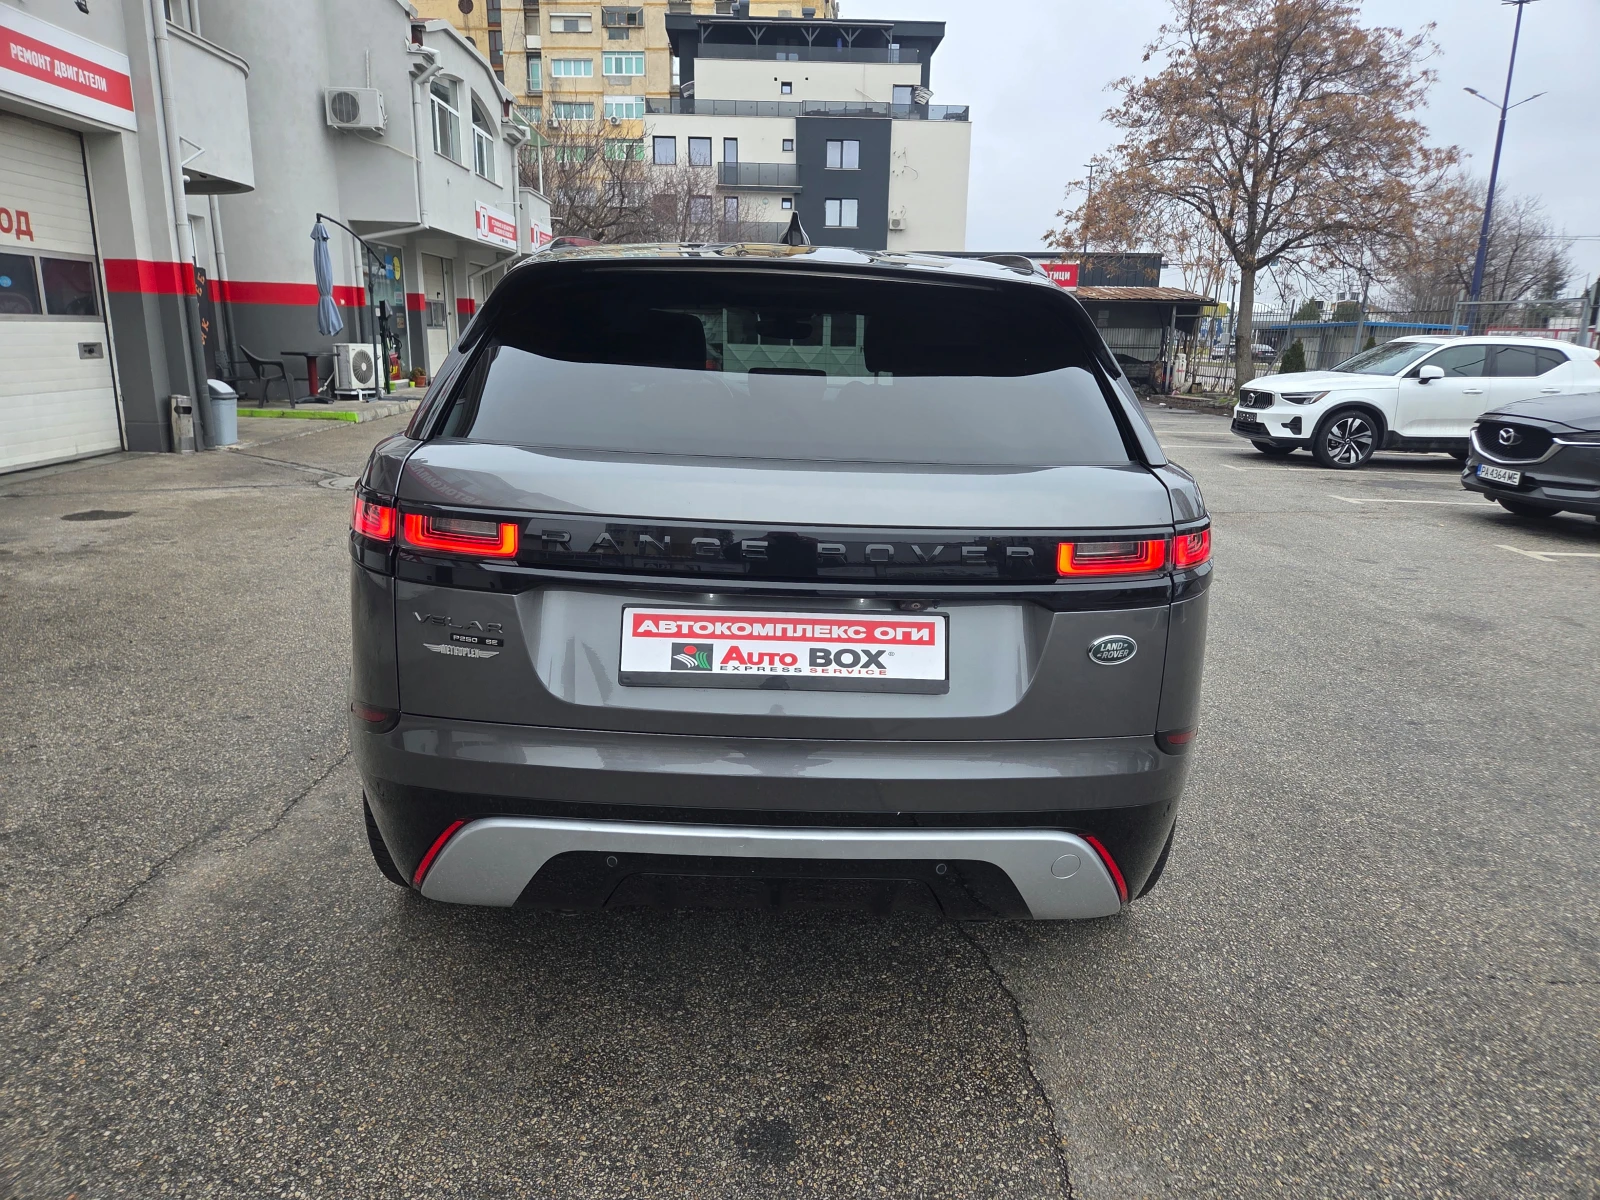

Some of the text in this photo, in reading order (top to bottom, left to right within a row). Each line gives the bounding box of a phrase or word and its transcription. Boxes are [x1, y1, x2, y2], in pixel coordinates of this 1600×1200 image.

[9, 42, 107, 92] РЕМОНТ ДВИГАТЕЛИ
[1046, 271, 1070, 281] ТИЦИ
[1489, 469, 1507, 481] 4364
[541, 529, 1035, 568] RANGE ROVER
[413, 611, 504, 634] VELAR
[636, 619, 930, 641] АВТОКОМПЛЕКС ОГИ
[453, 634, 478, 644] P250
[1100, 642, 1123, 651] LAND
[1101, 649, 1129, 659] ROVER
[719, 665, 888, 676] EXPRESS SERVICE
